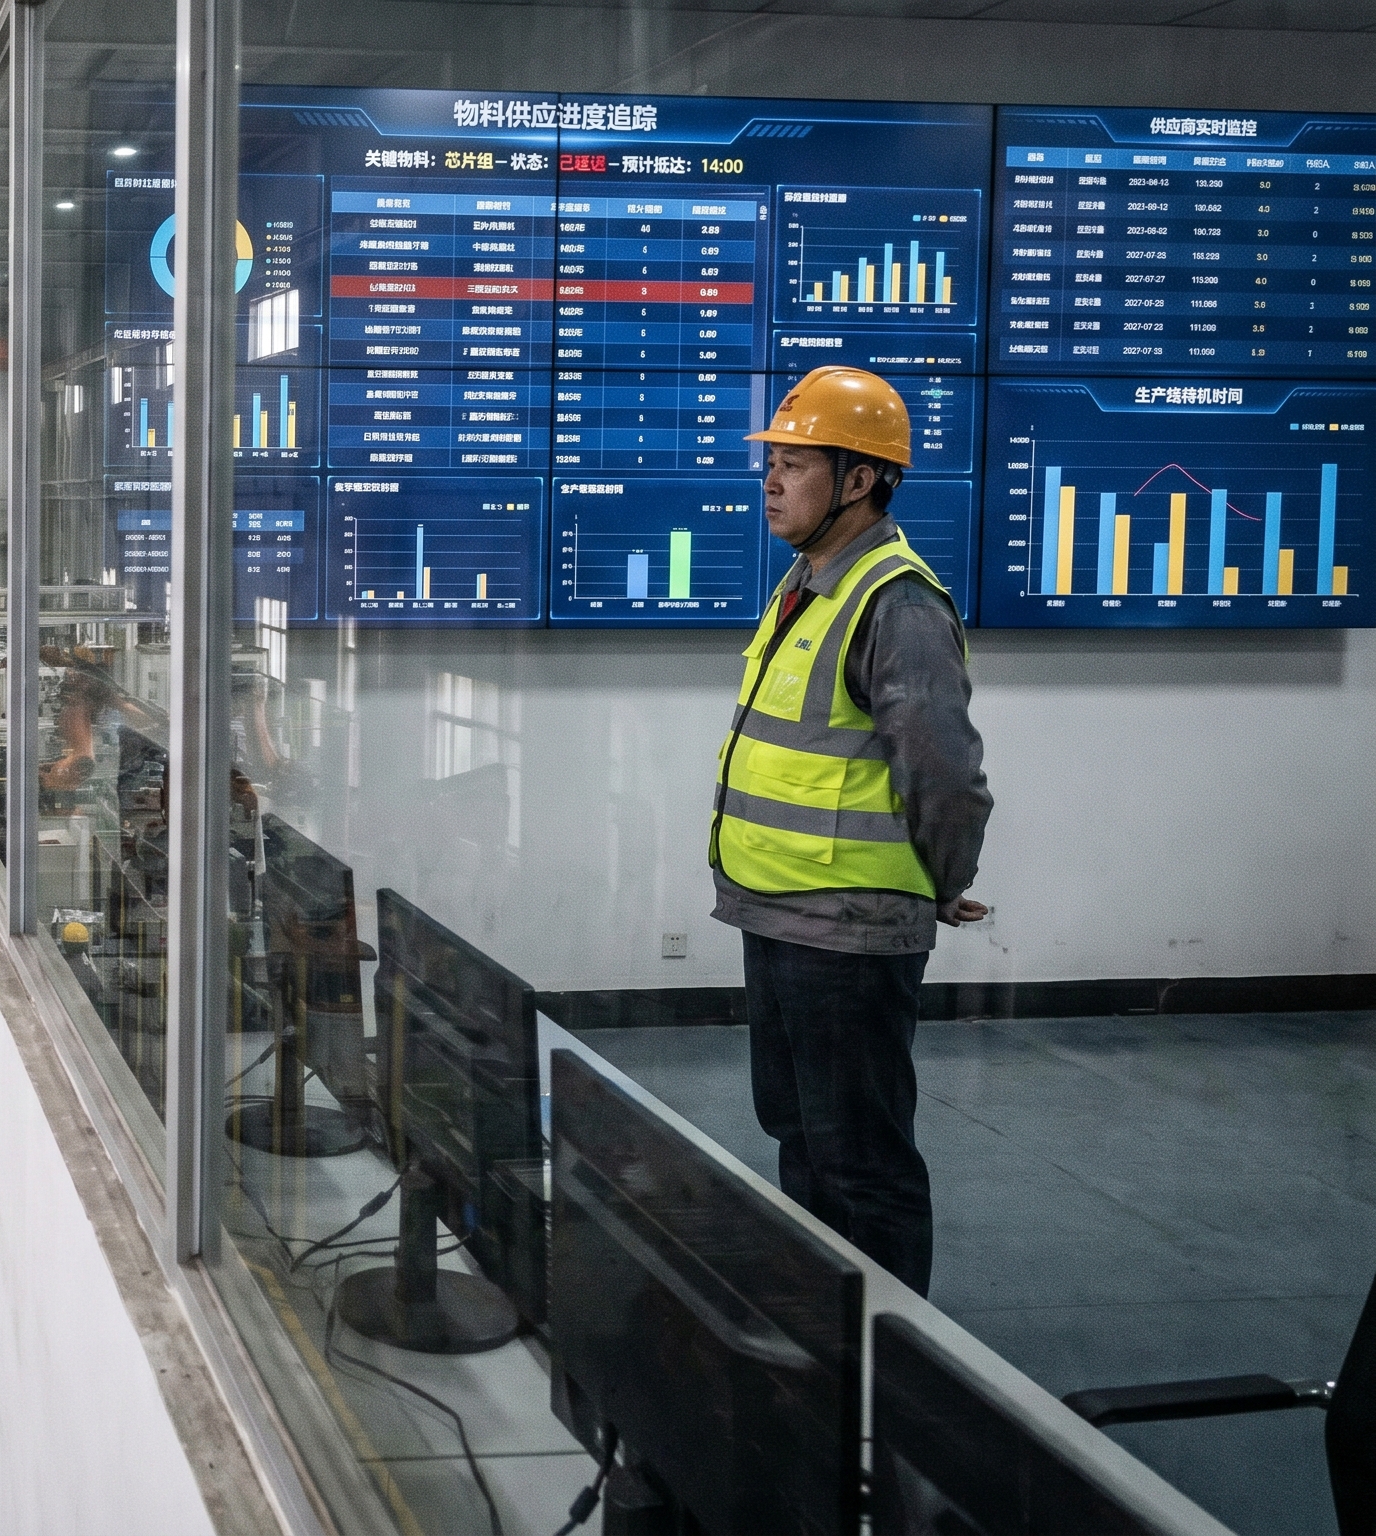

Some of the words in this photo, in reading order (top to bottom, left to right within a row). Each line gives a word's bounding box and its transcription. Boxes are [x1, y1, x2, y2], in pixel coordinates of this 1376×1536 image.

[453, 99, 657, 132] 物料供应进度追踪
[1149, 117, 1258, 137] 供应商实时监控
[701, 158, 744, 174] 14:00
